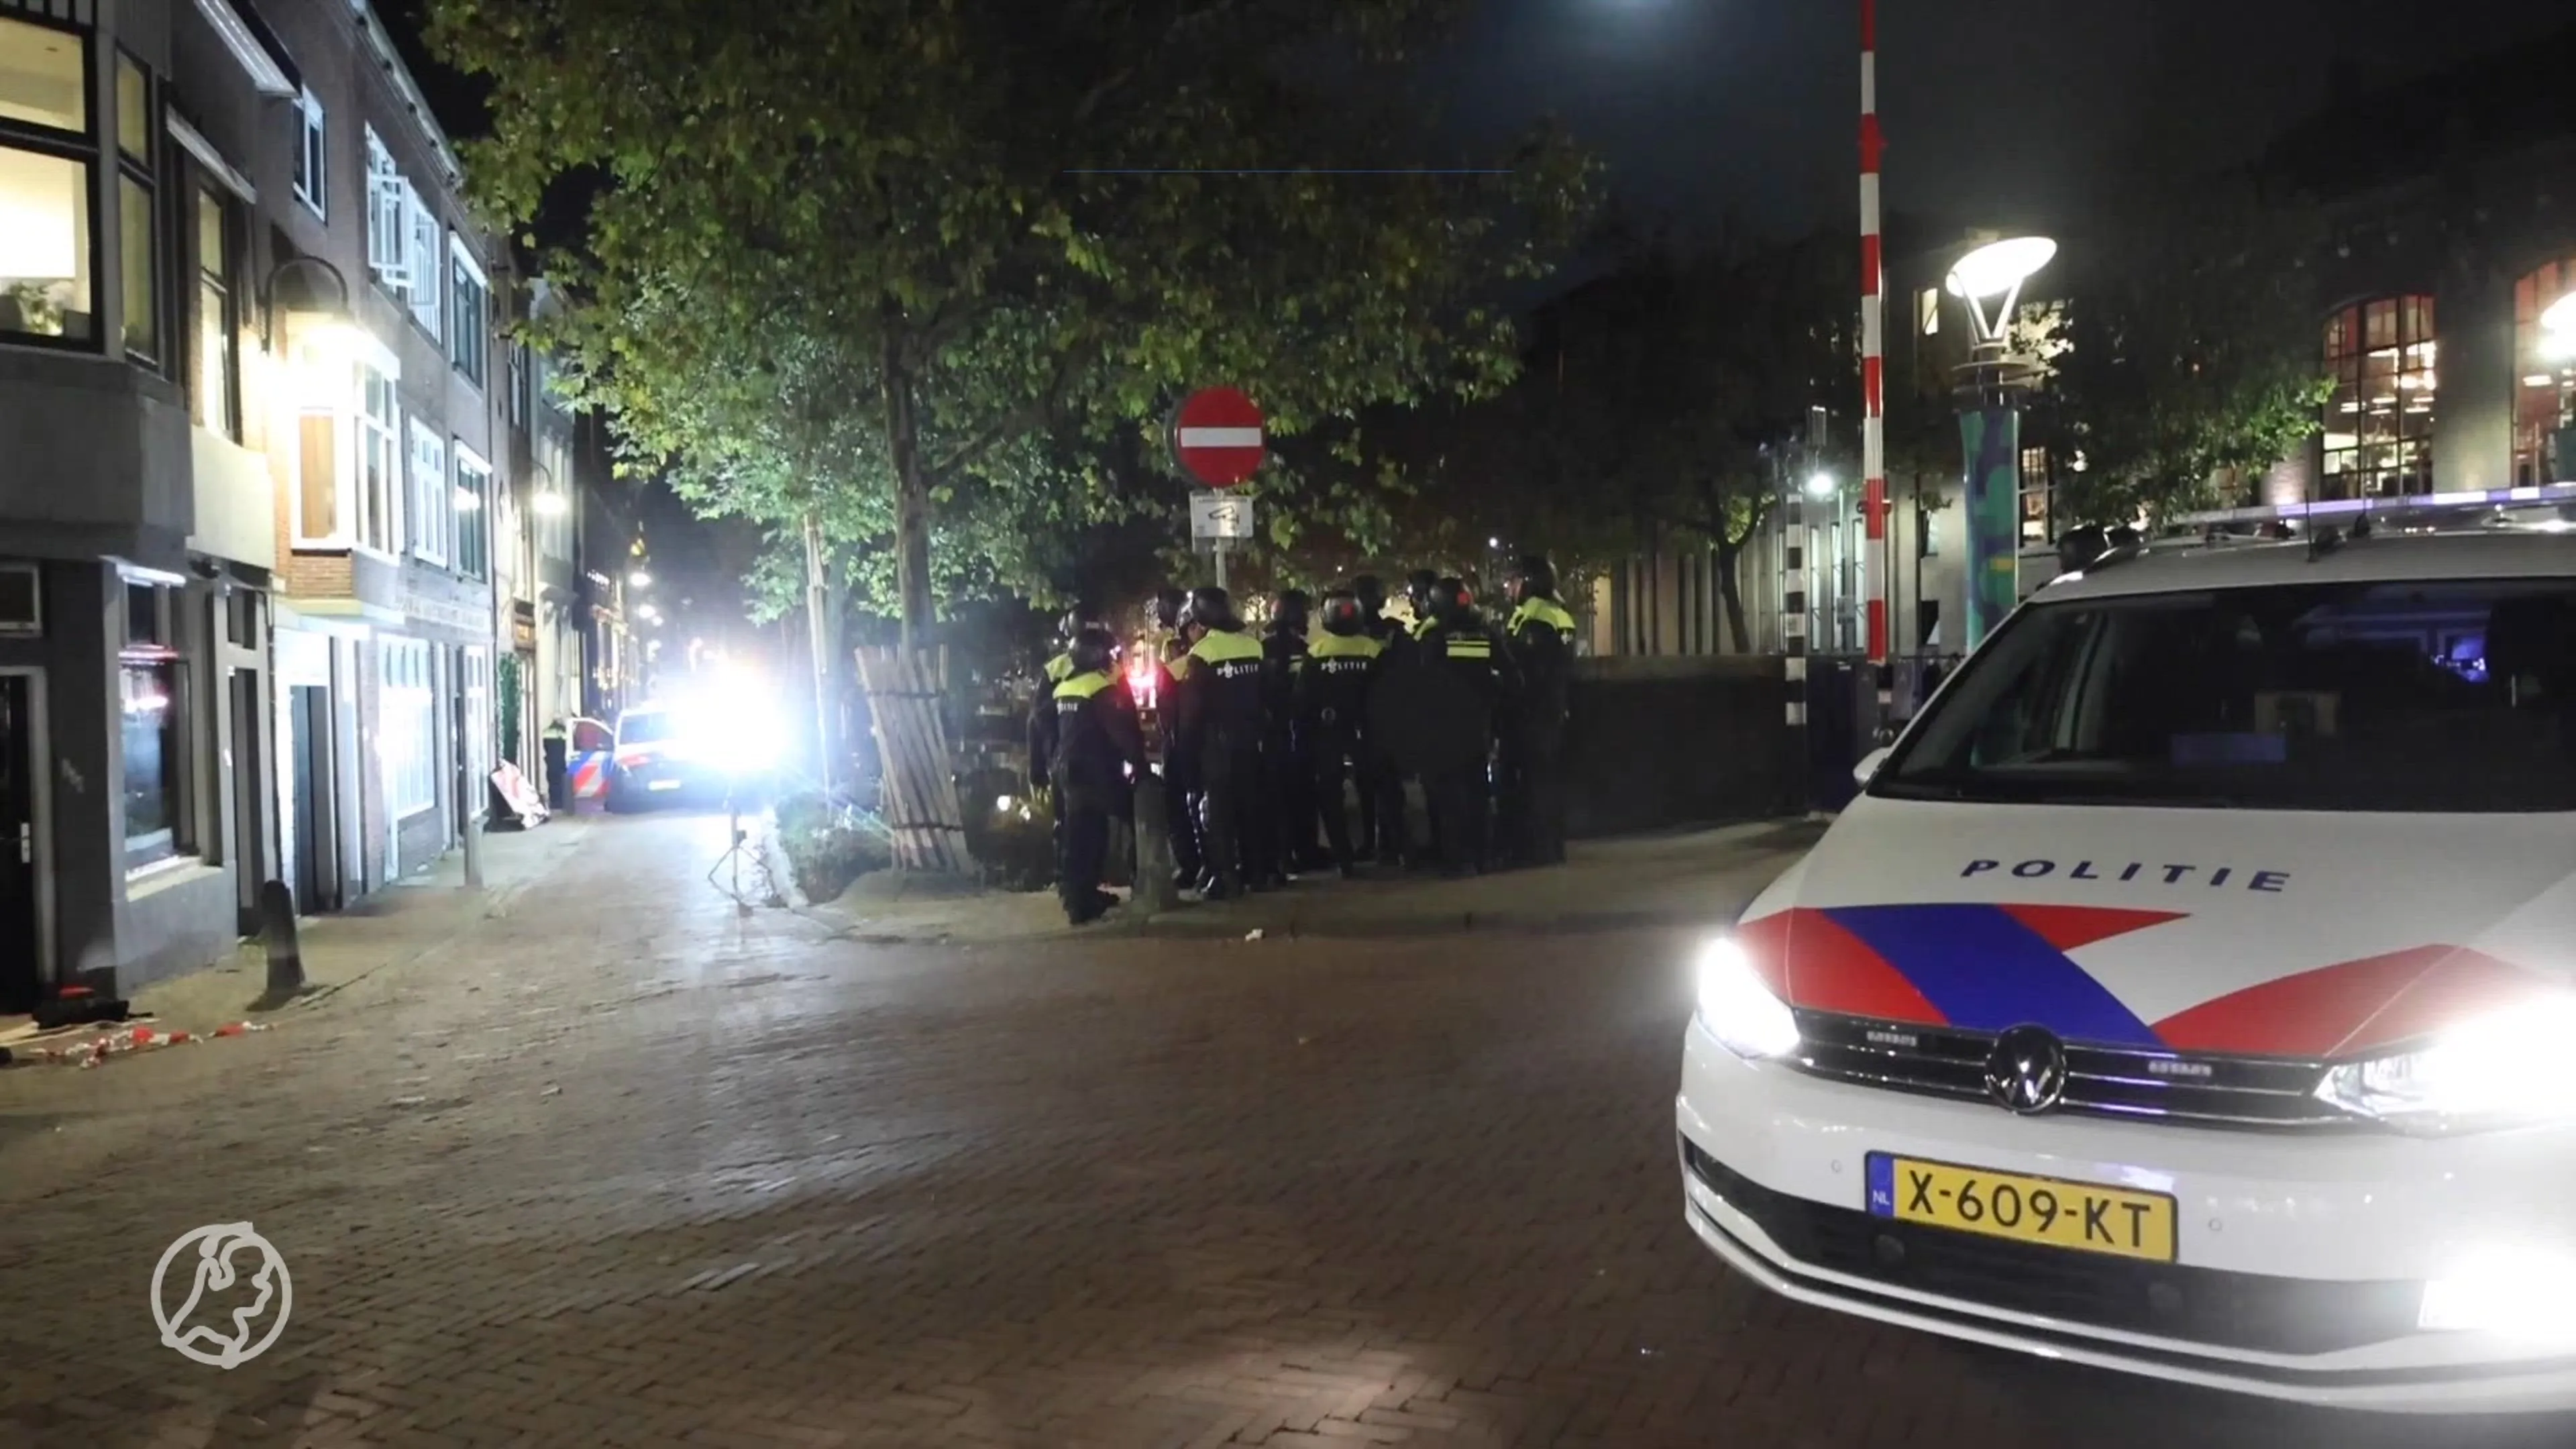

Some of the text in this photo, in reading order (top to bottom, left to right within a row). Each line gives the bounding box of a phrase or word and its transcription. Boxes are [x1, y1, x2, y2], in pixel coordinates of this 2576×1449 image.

[1960, 859, 2291, 893] POLITIE
[1872, 1169, 2151, 1248] NL X-609-KT
